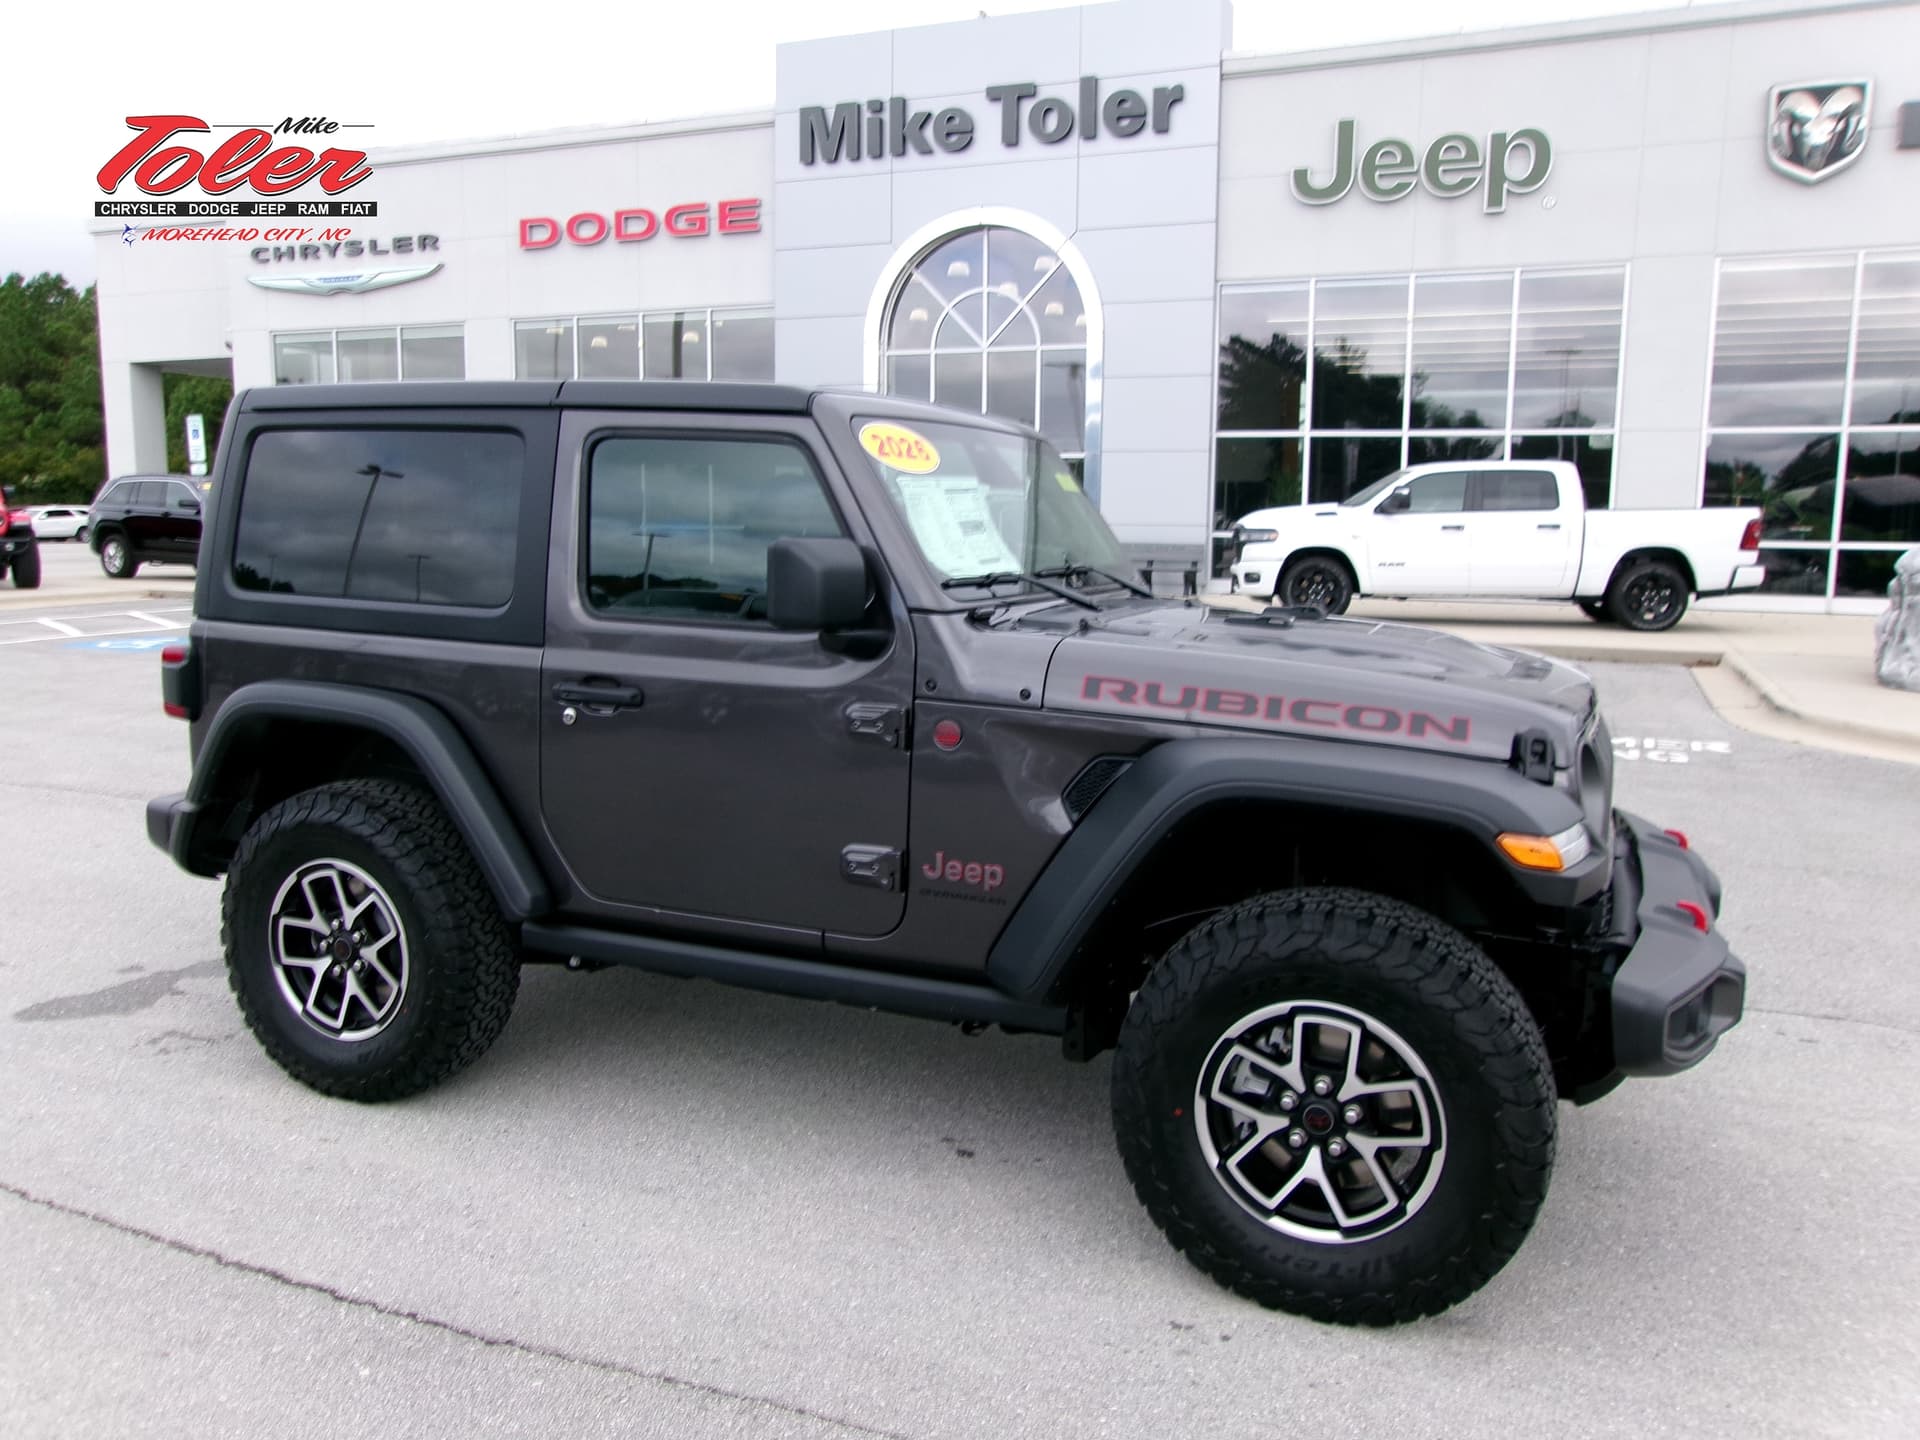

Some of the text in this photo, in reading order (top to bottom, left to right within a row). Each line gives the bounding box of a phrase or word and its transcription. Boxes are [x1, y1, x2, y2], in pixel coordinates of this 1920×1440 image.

[800, 75, 1185, 166] Mike Toler
[1292, 118, 1552, 214] Jeep
[250, 234, 441, 264] CHRYSLER
[518, 199, 761, 250] DODGE
[1080, 674, 1471, 743] RUBICON
[921, 851, 1005, 893] Jeep
